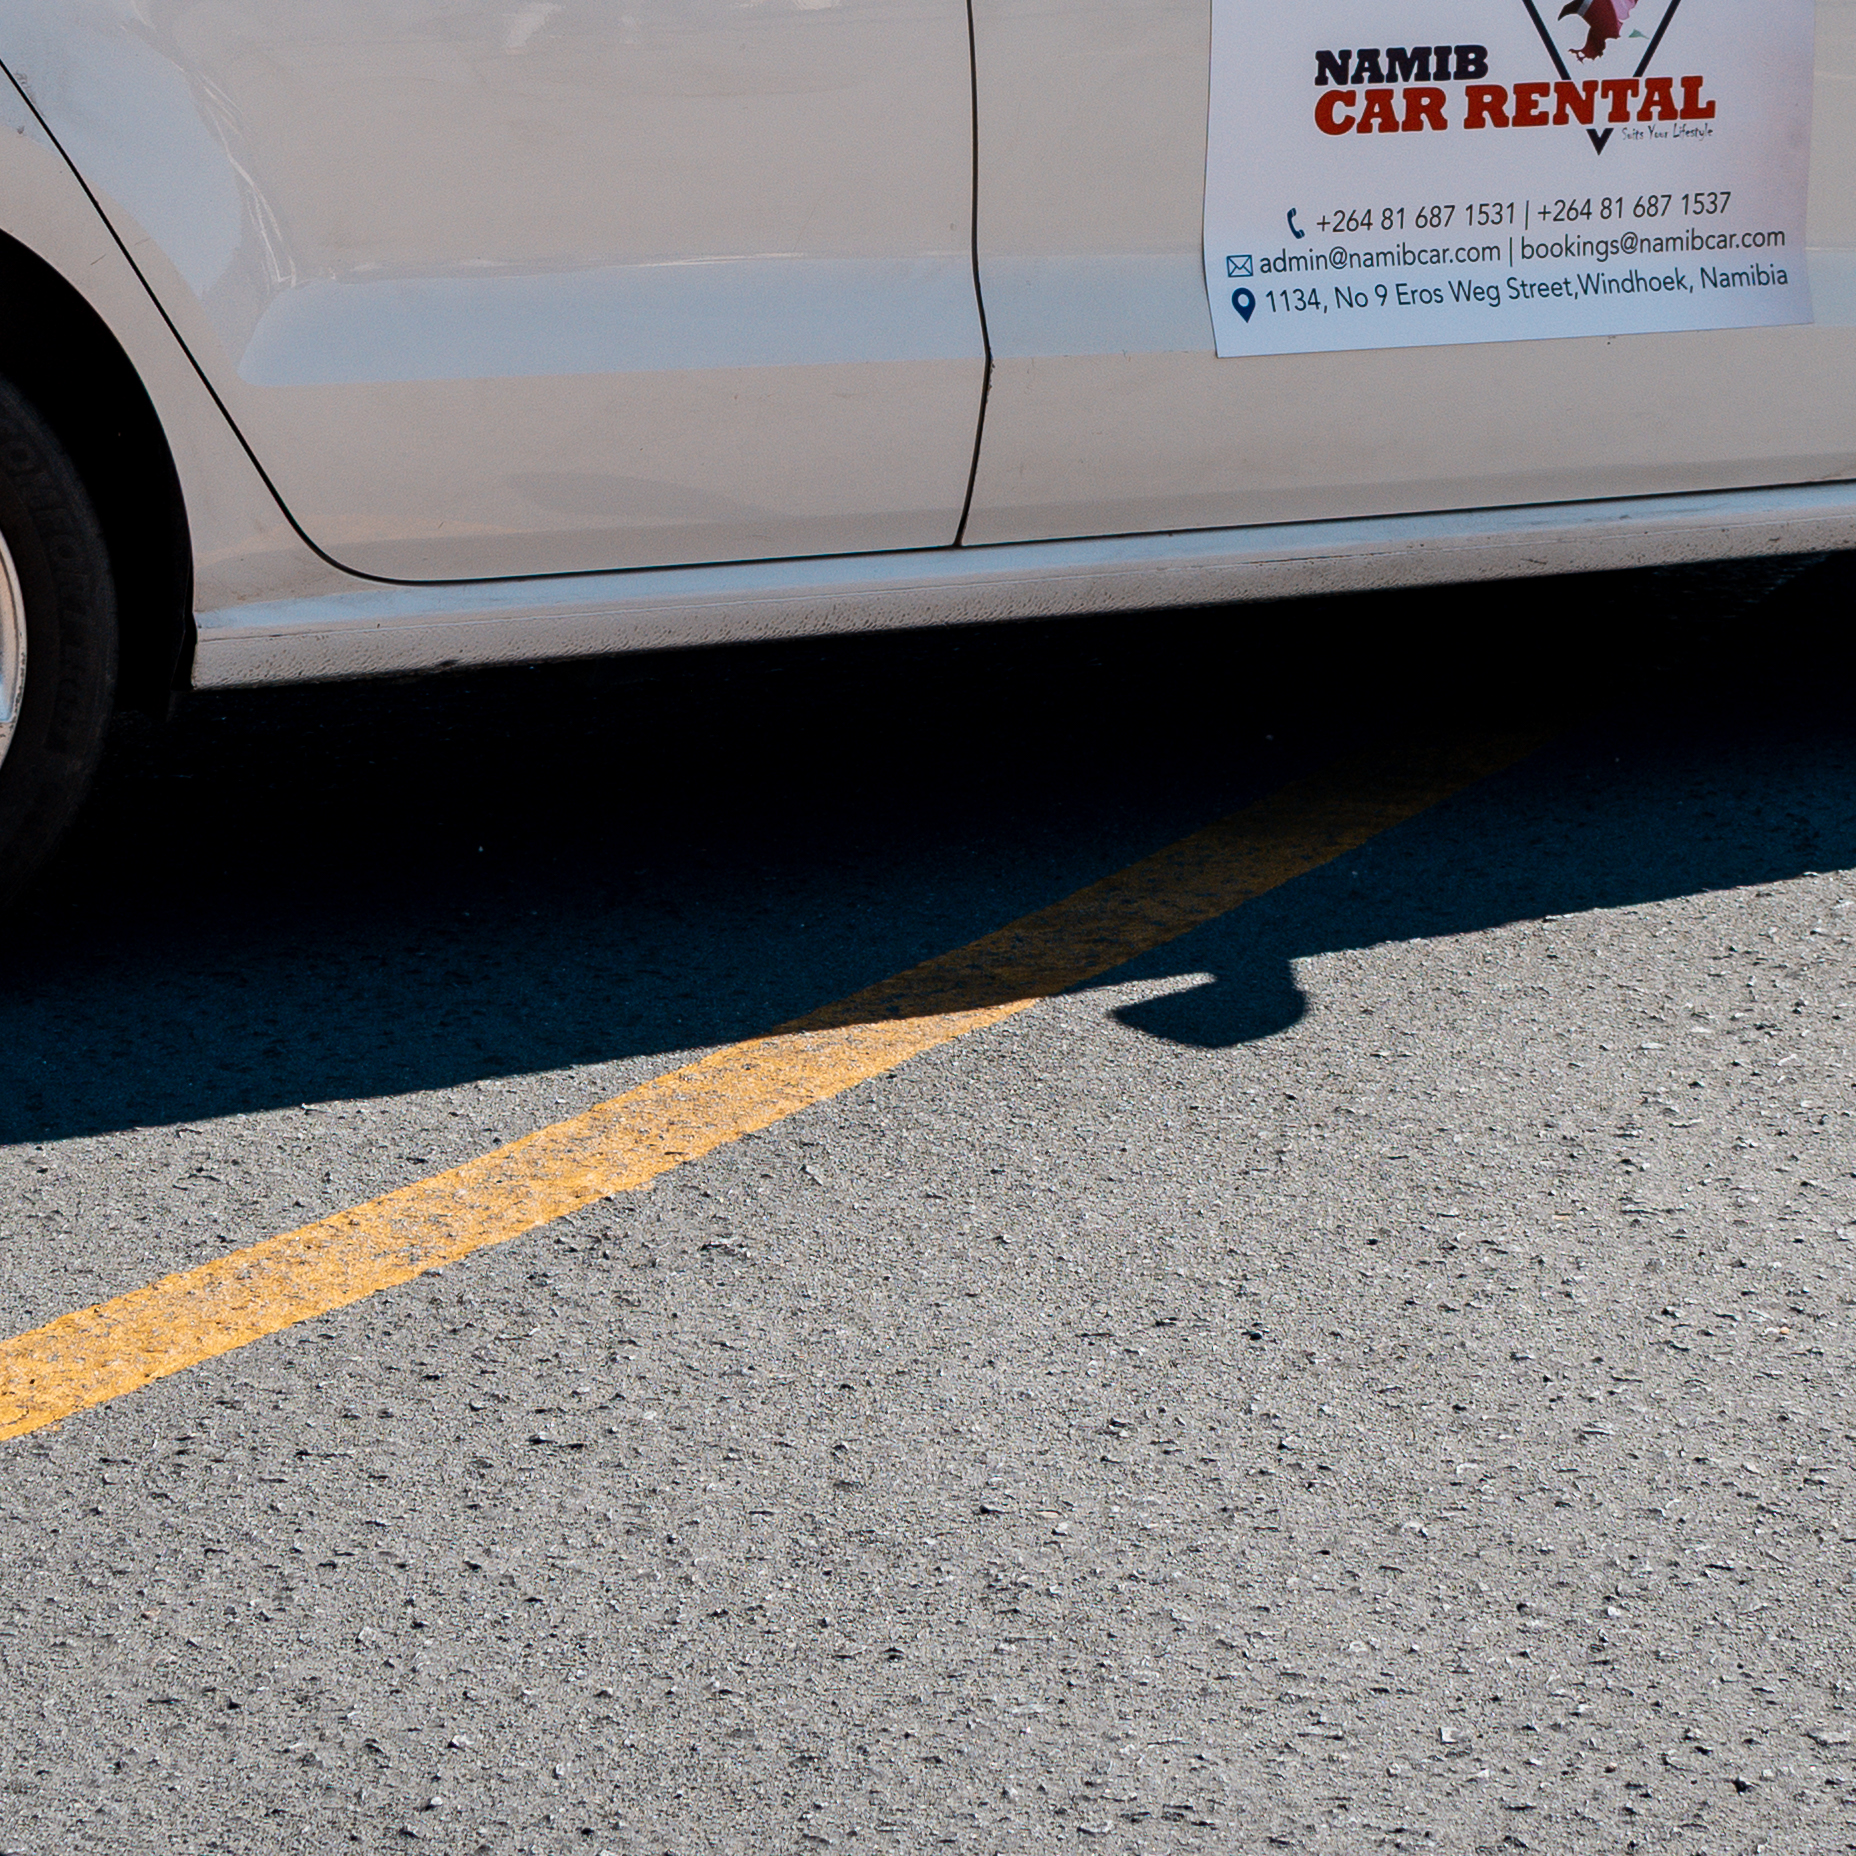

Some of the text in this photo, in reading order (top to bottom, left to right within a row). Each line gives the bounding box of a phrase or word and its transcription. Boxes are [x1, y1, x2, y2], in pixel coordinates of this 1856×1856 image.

[1314, 44, 1488, 85] NAMIB
[1314, 76, 1715, 136] CAR RENTAL
[1673, 123, 1713, 142] Lifestyle
[1317, 208, 1373, 233] +264
[1381, 207, 1405, 230] 81
[1415, 205, 1456, 229] 687
[1466, 202, 1515, 227] 1531
[1538, 198, 1593, 222] +264
[1600, 197, 1624, 220] 81
[1633, 194, 1672, 218] 687
[1682, 191, 1732, 215] 1537
[1259, 242, 1501, 274] admin@namibcar.com
[1521, 227, 1786, 262] bookings@namibcar.com
[1265, 287, 1328, 313] 1134,
[1334, 285, 1369, 309] No
[1375, 283, 1388, 307] 9
[1395, 282, 1444, 305] Eros
[1448, 279, 1501, 307] Weg
[1700, 263, 1789, 290] Namibia
